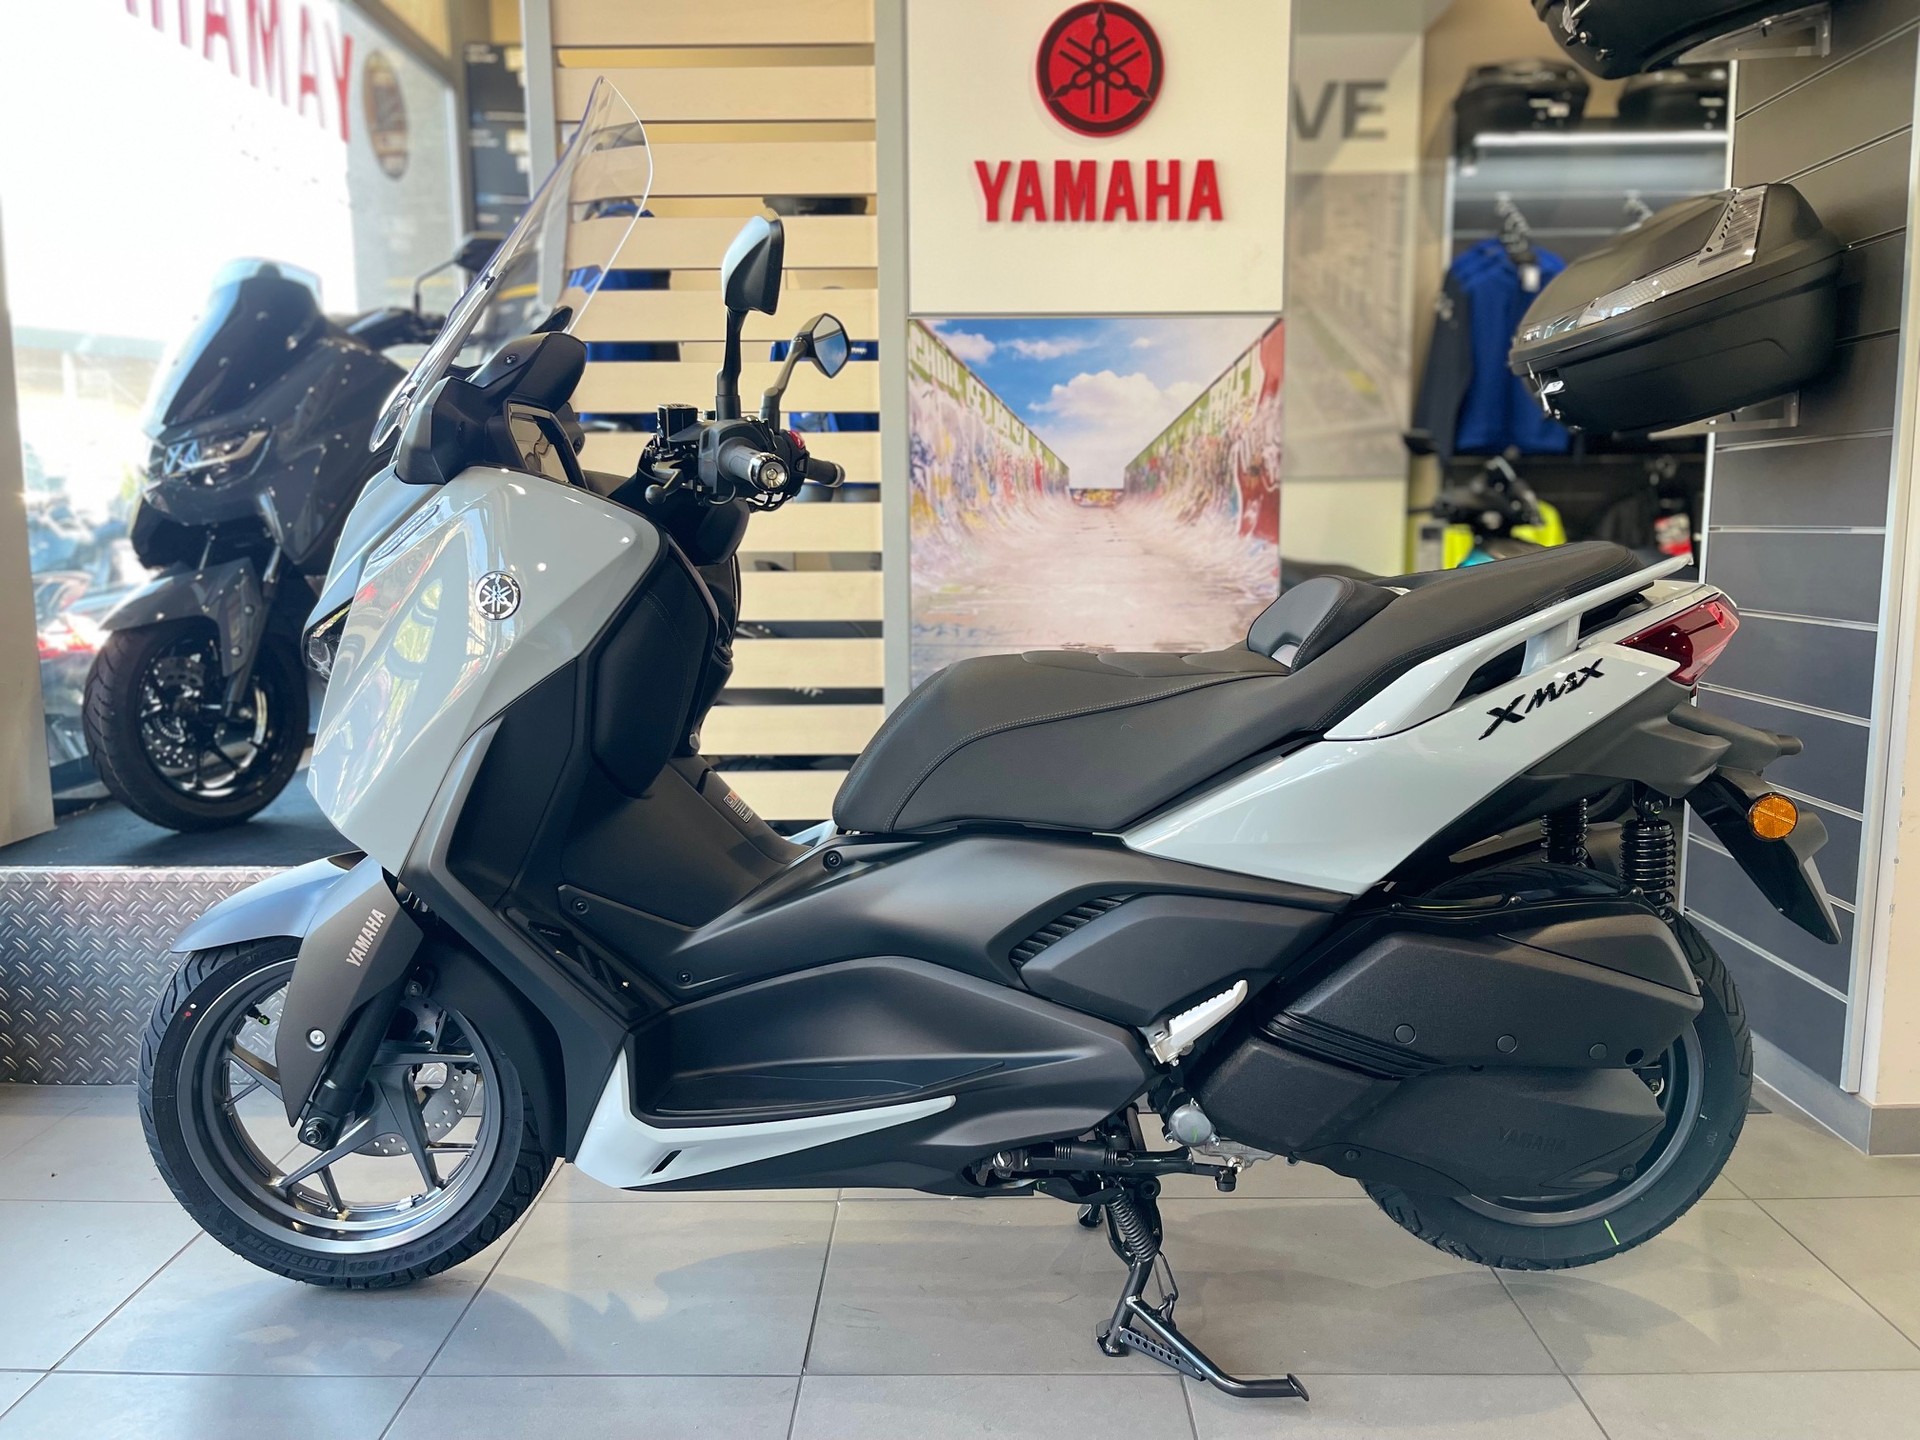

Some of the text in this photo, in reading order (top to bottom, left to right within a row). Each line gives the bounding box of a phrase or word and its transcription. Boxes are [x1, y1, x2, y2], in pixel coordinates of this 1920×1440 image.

[974, 159, 1223, 223] YAMAHA
[345, 908, 387, 967] YAMAHA
[242, 1233, 334, 1273] MICHELIN
